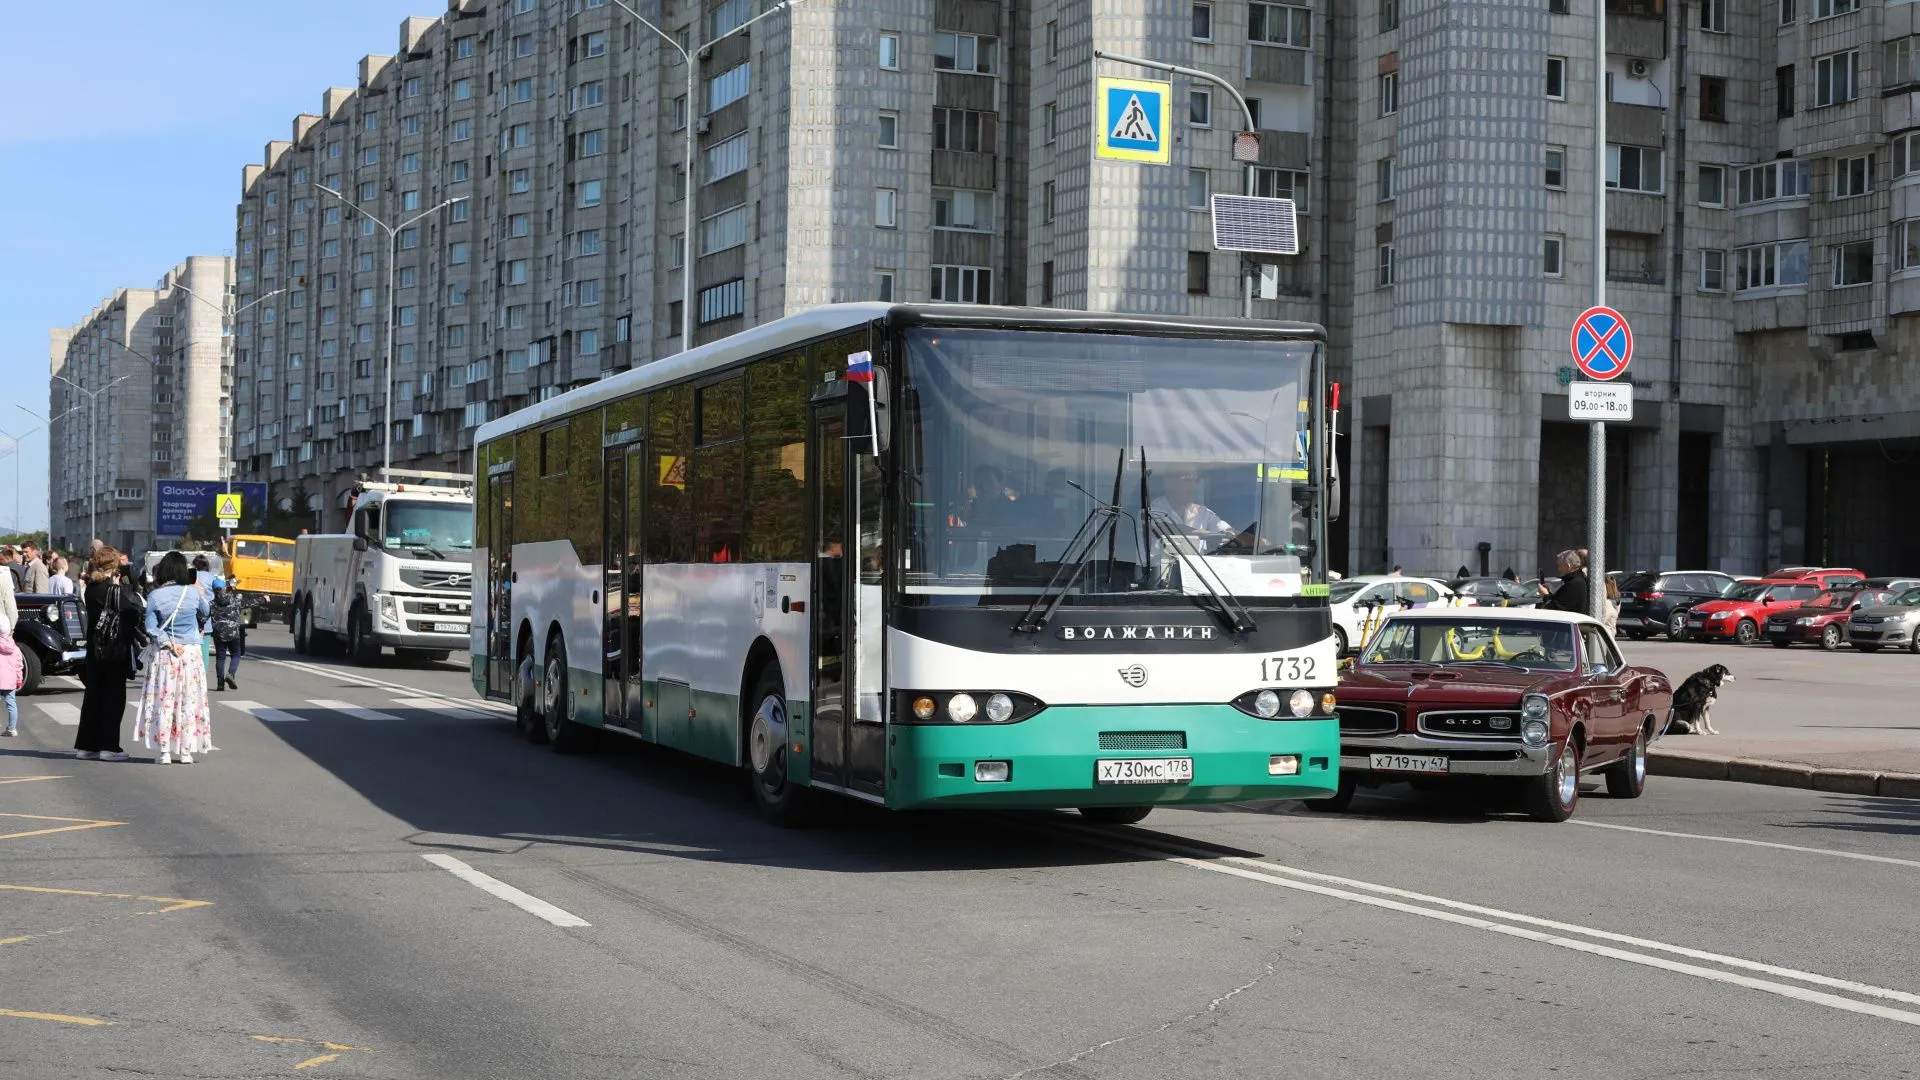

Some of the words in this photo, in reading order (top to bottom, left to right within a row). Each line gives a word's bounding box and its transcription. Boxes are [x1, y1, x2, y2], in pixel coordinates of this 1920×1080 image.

[1584, 390, 1617, 398] вторник
[162, 486, 206, 496] GloraX
[1064, 627, 1211, 639] ВОЛЖАНИН
[1261, 656, 1316, 681] 1732
[1166, 760, 1188, 772] 178
